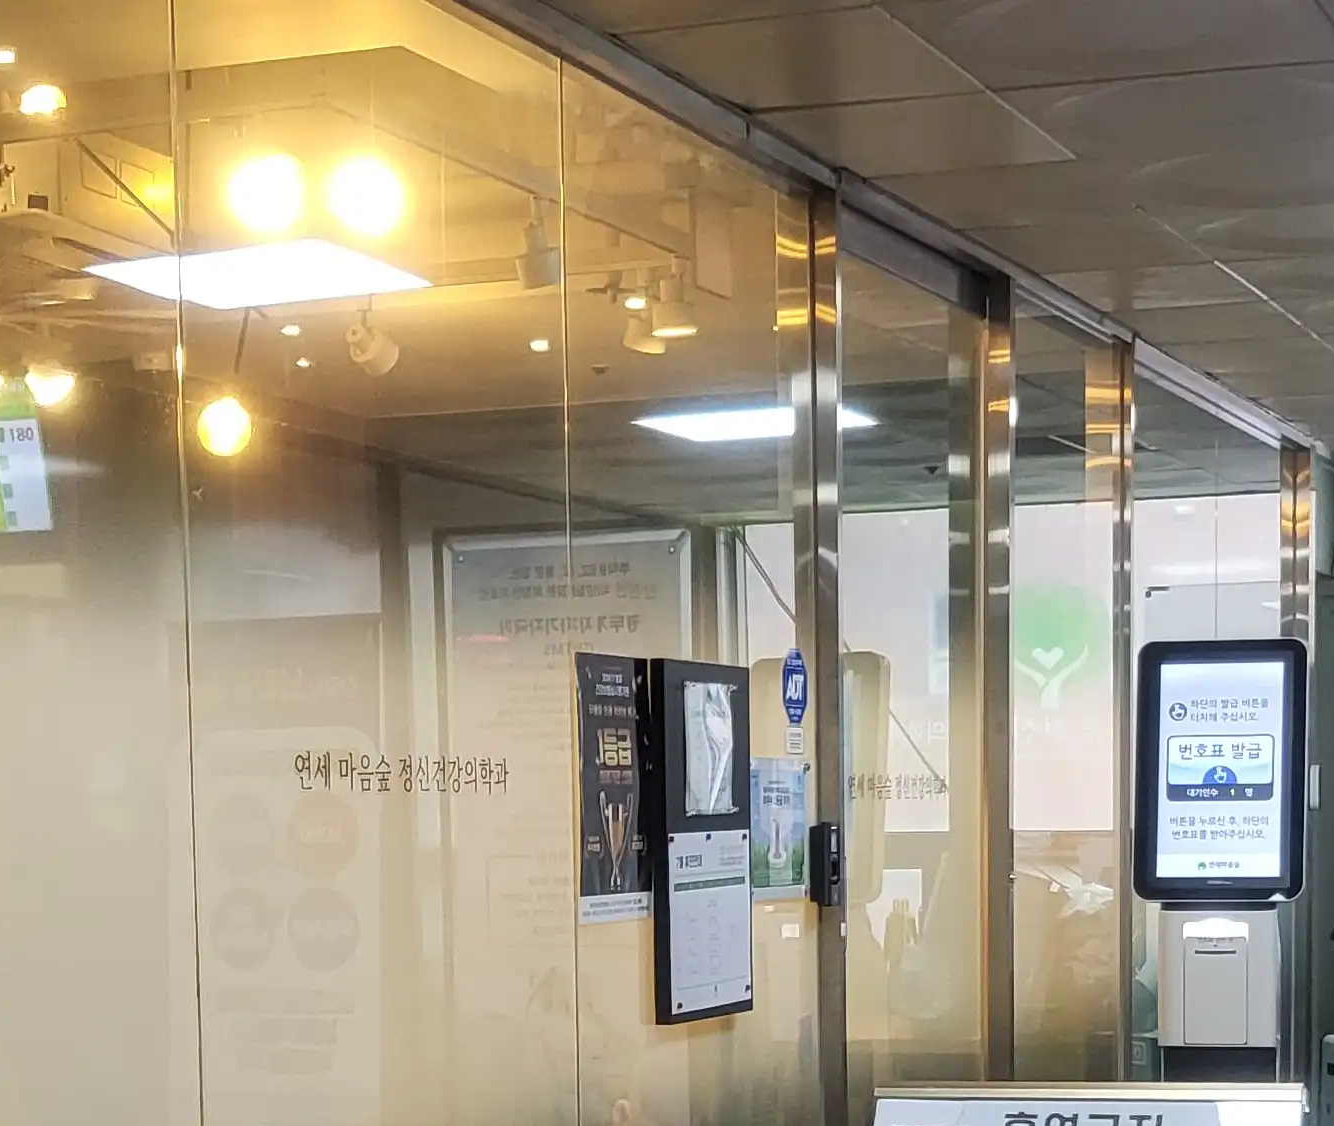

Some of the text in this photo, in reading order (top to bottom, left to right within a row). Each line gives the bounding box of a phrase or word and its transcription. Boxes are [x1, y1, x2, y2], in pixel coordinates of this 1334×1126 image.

[785, 674, 805, 701] ADT
[1179, 742, 1262, 760] 번호표 발급
[293, 750, 510, 796] 연세 마음숲 정신건강의학과
